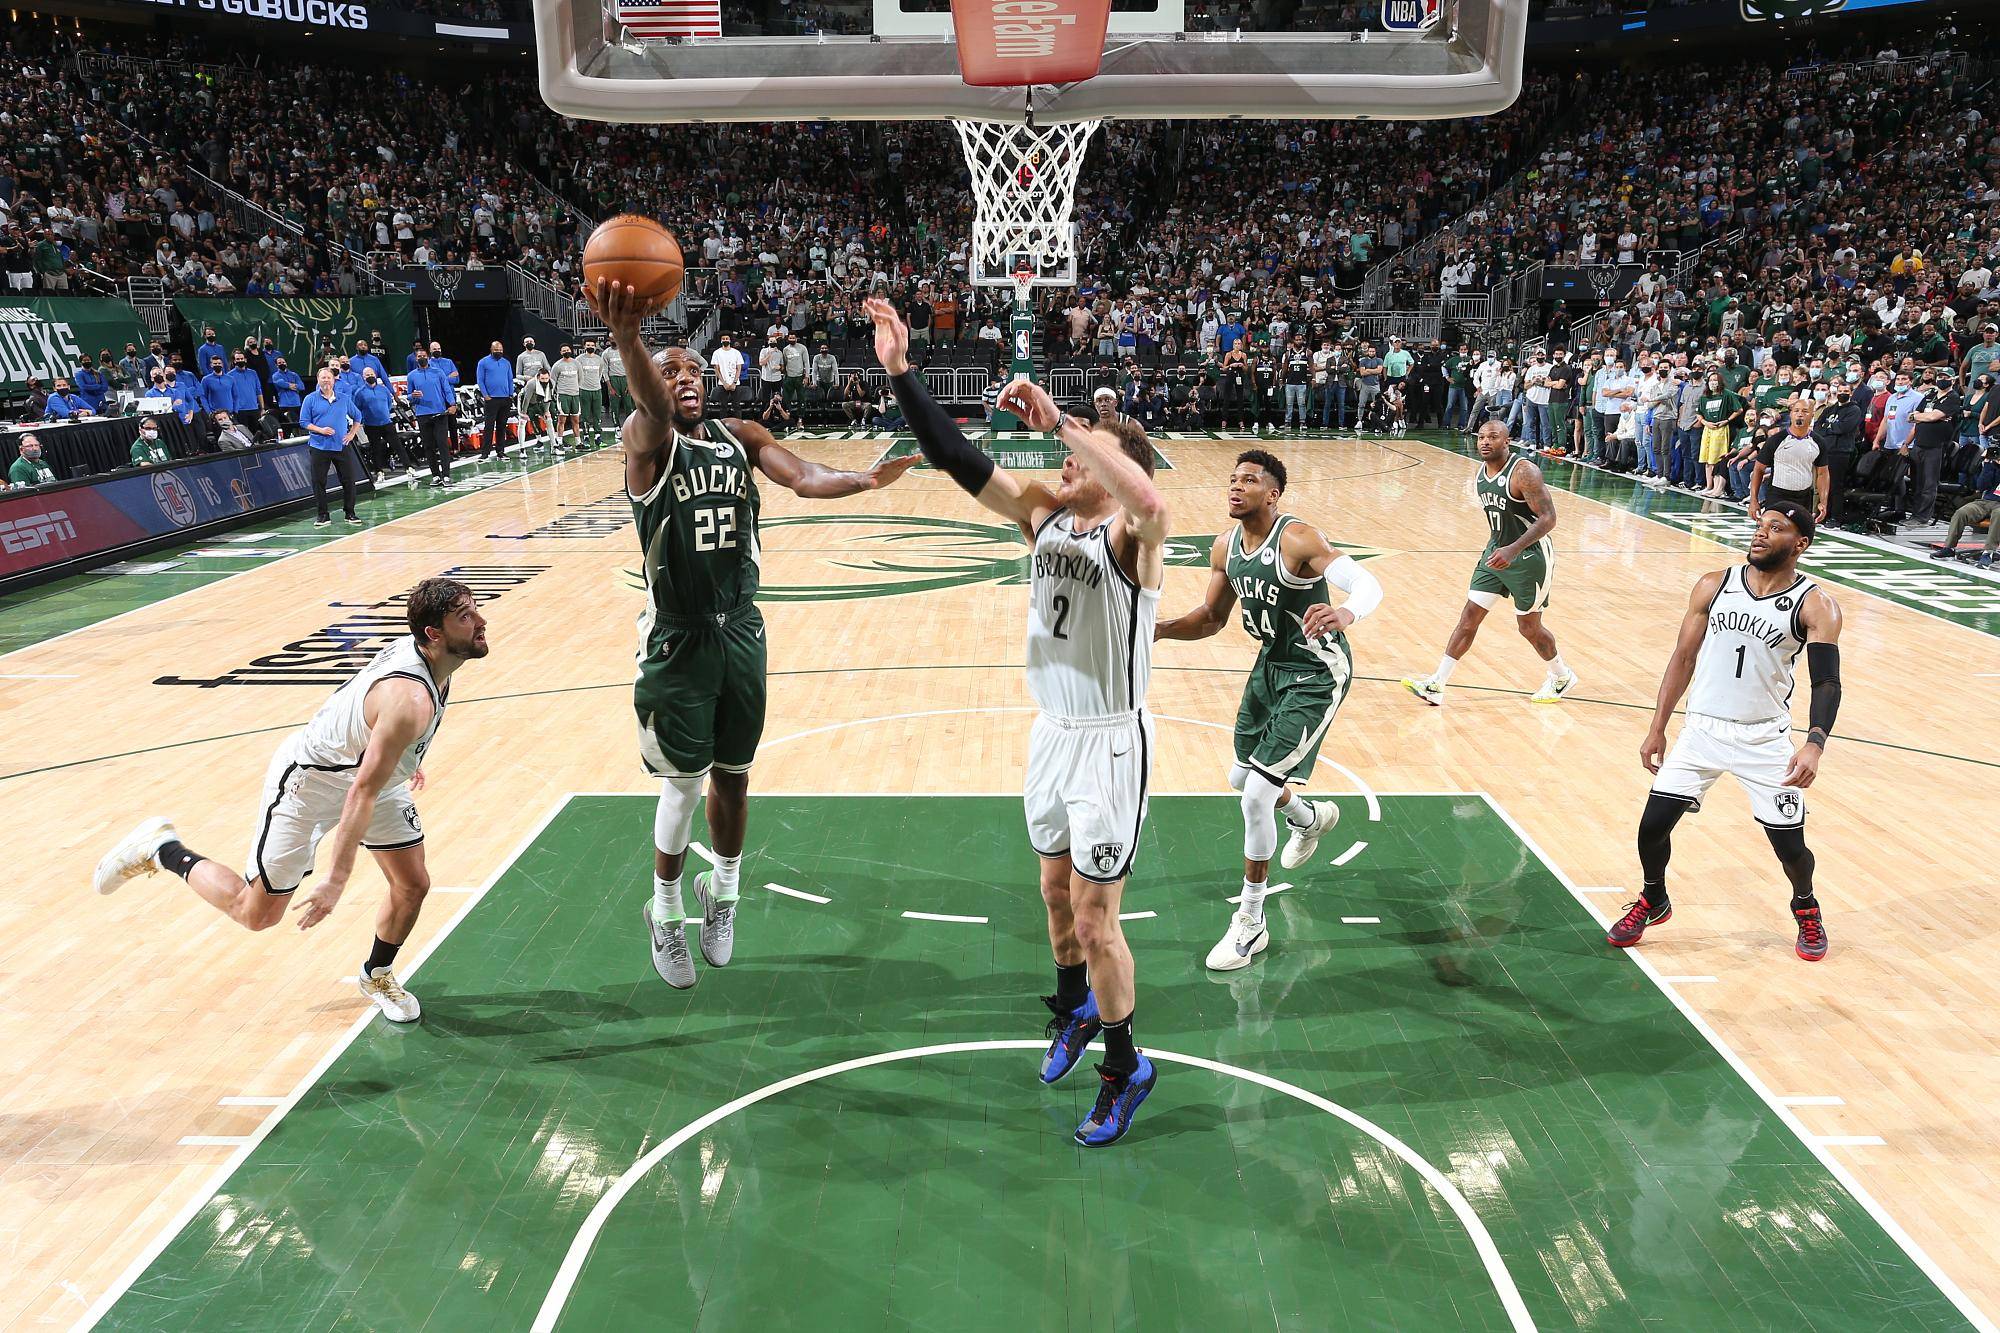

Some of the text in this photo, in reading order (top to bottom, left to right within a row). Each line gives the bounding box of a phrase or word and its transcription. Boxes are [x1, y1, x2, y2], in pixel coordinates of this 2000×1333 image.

[262, 0, 368, 30] BUCKS
[1390, 0, 1417, 22] NBA
[0, 322, 81, 382] UCKS
[271, 453, 311, 492] NEXT
[671, 464, 748, 503] BUCKS
[196, 476, 222, 506] VS
[0, 510, 77, 554] ESPN
[694, 506, 737, 552] 22
[1488, 510, 1502, 532] 17
[1035, 552, 1104, 590] BROOKLYN
[1230, 576, 1280, 607] UCKS
[1052, 594, 1070, 640] 2
[1242, 609, 1276, 639] 34
[1710, 611, 1787, 650] BROOKLYN
[1734, 644, 1746, 679] 1
[1775, 794, 1799, 805] NETS
[1094, 844, 1123, 858] NETS
